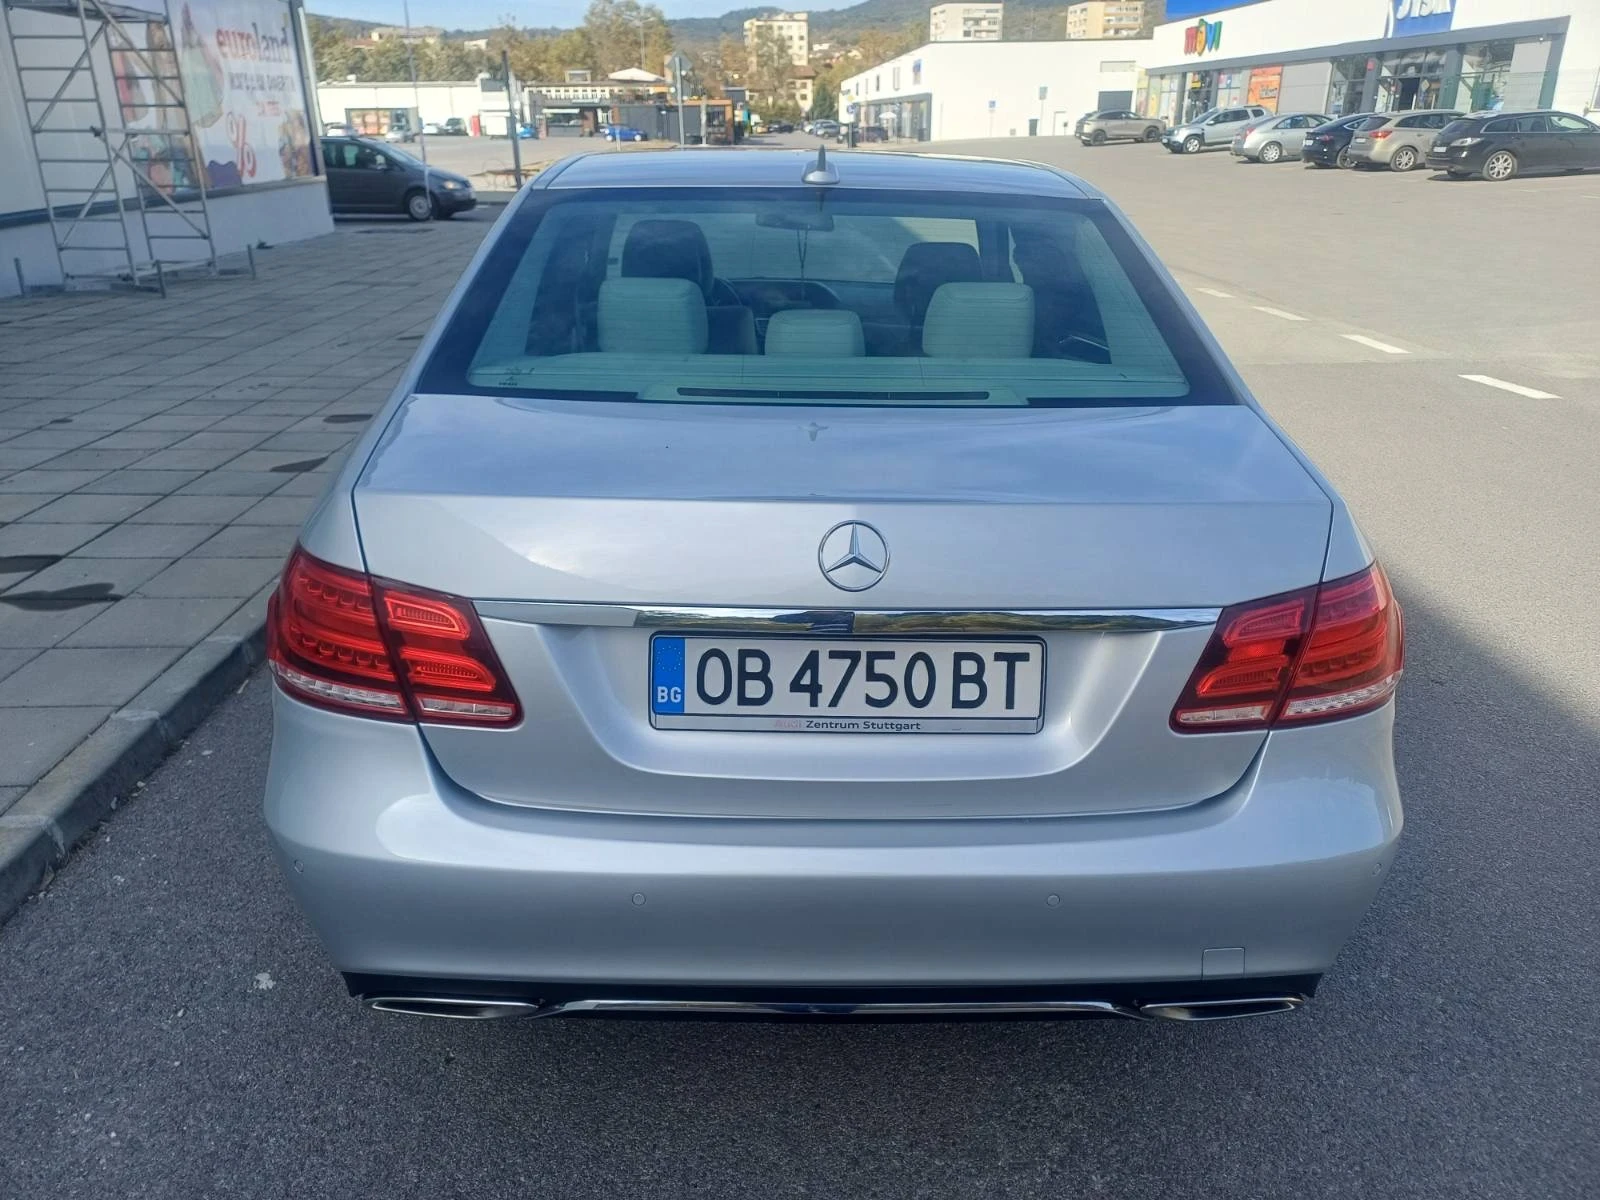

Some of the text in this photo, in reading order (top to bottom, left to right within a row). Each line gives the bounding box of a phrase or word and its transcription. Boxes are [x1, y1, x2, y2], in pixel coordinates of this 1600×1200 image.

[696, 648, 1030, 710] OB 4750 BT
[657, 686, 682, 703] BG
[805, 719, 860, 730] Zentrum
[862, 720, 921, 732] Stuttgart
